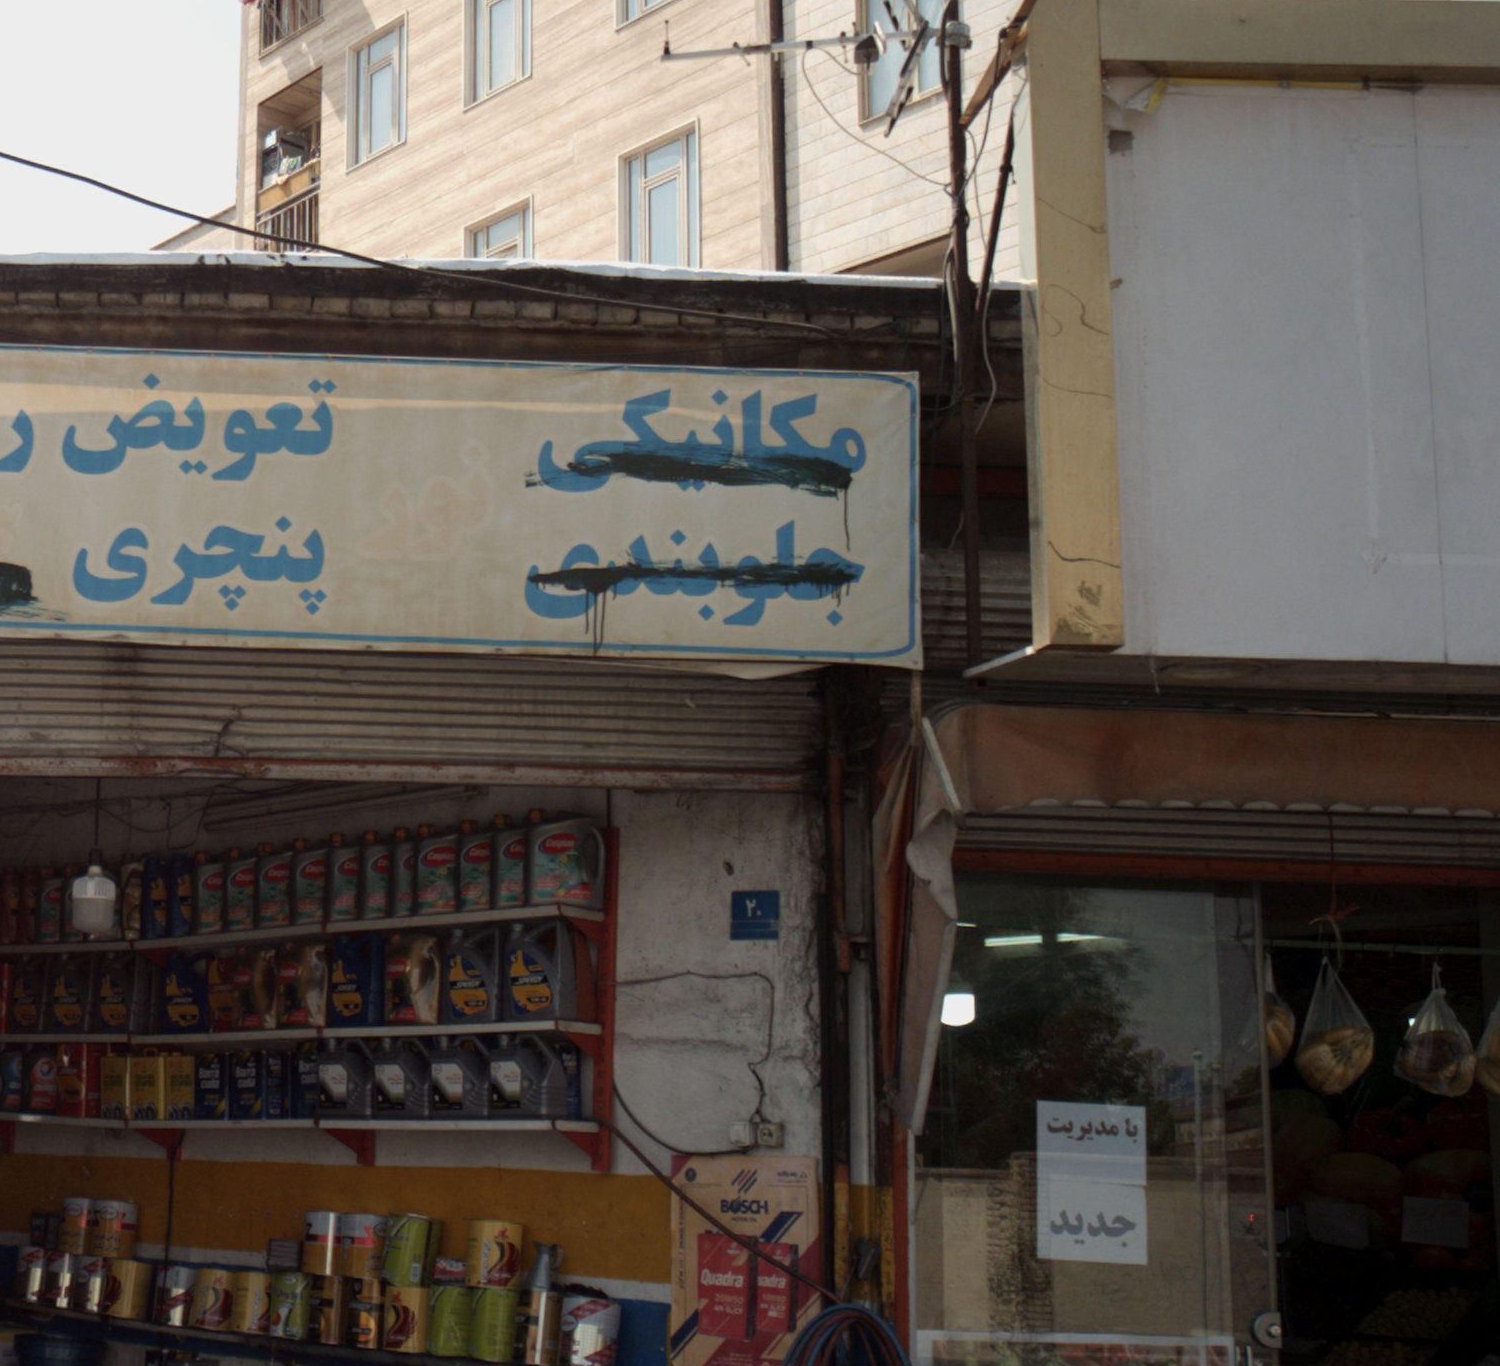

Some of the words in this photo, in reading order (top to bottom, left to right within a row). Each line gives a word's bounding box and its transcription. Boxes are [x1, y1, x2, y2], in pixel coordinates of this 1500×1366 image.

[61, 371, 338, 482] تعویض
[537, 388, 868, 494] مکانیکی
[72, 515, 328, 616] پنچری
[524, 519, 866, 628] جلوبندی
[744, 897, 763, 918] ۲۰
[1046, 1116, 1120, 1142] مدیریت
[720, 1199, 769, 1214] BOSCH
[1049, 1208, 1137, 1248] جدید
[700, 1268, 745, 1288] Quadra
